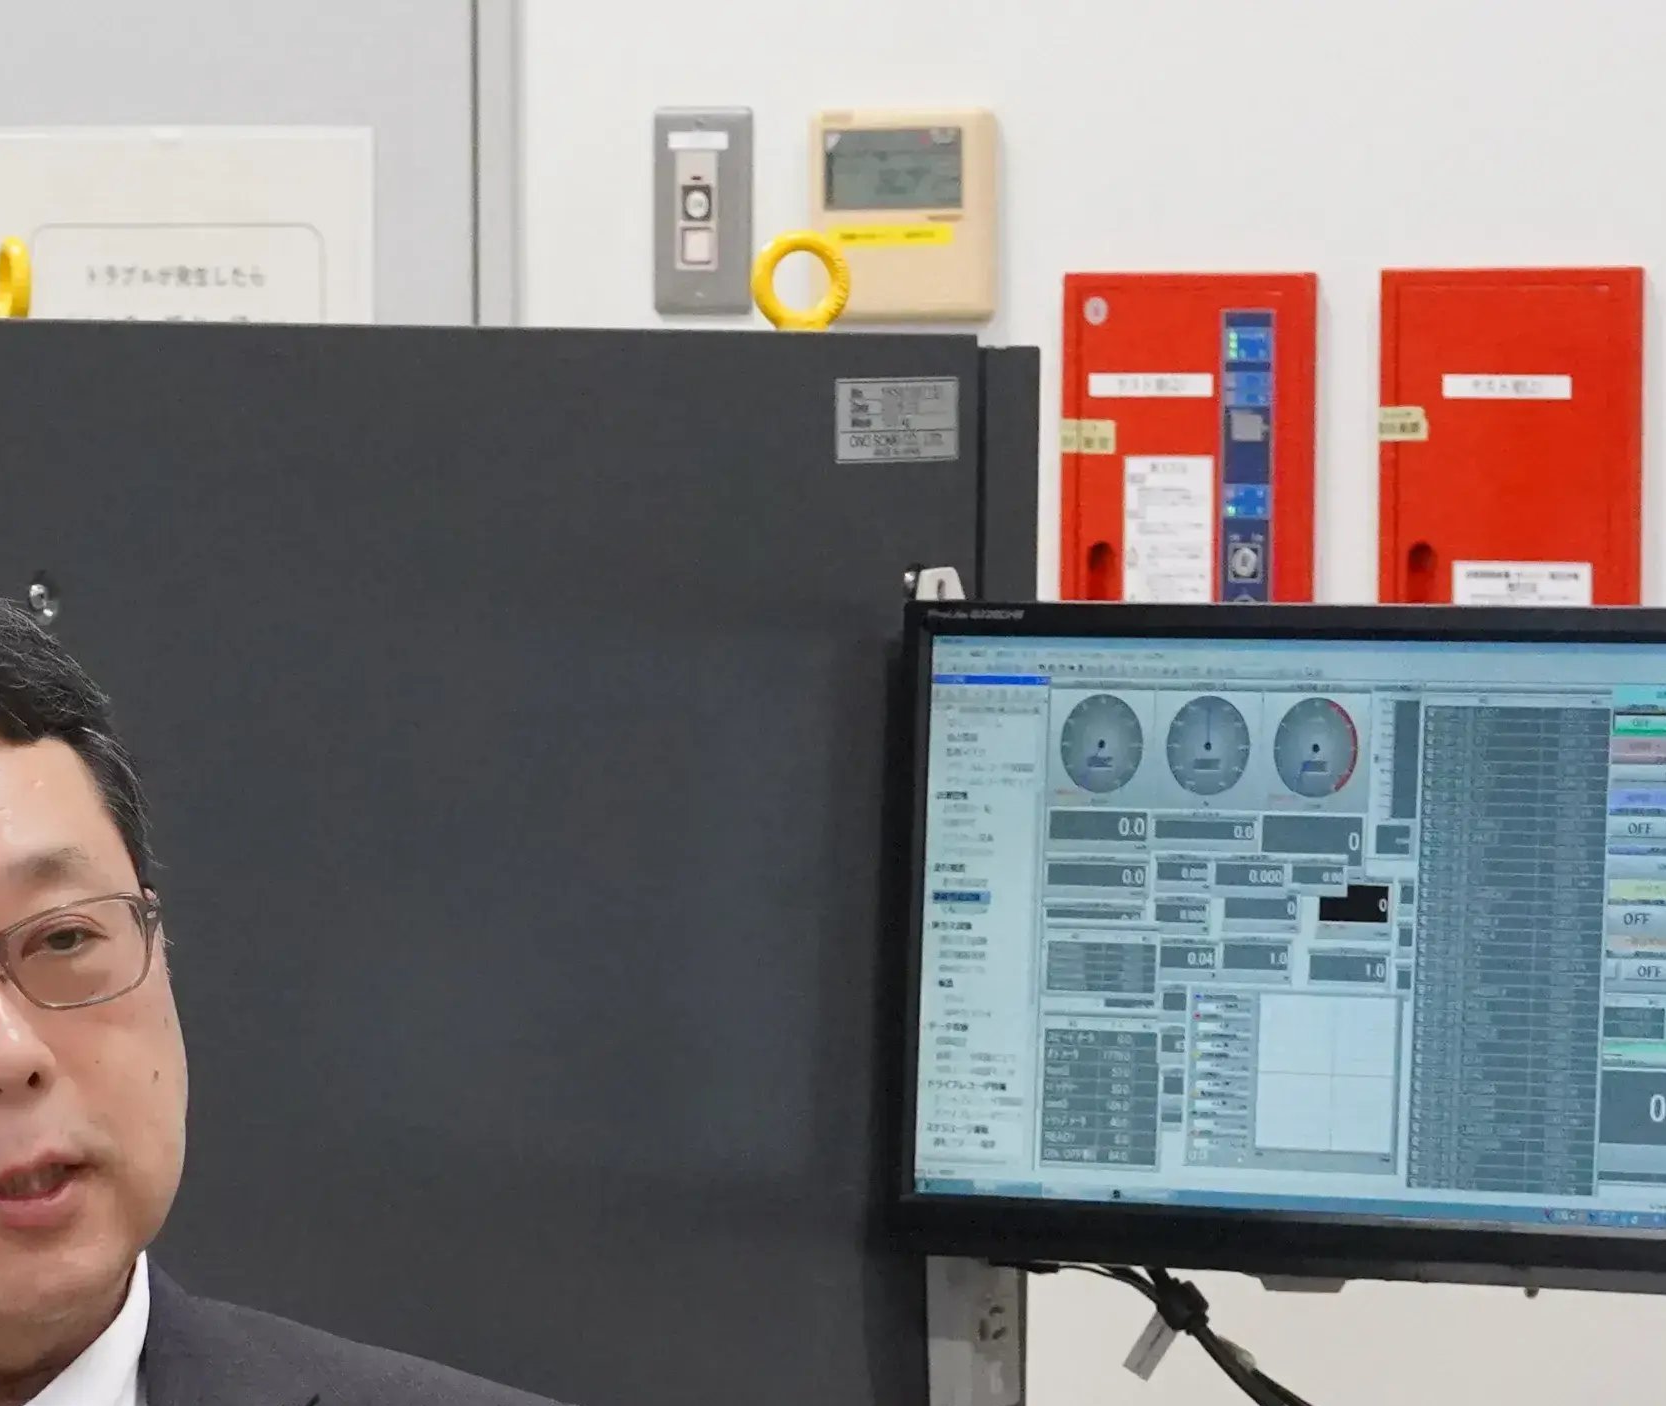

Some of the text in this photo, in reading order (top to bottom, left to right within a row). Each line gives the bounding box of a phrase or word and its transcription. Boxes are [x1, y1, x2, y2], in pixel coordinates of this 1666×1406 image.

[1117, 817, 1146, 836] 0.0
[1627, 822, 1653, 835] OFF
[1348, 832, 1361, 851] 0
[1623, 912, 1650, 926] OFF
[1637, 965, 1662, 978] OFF
